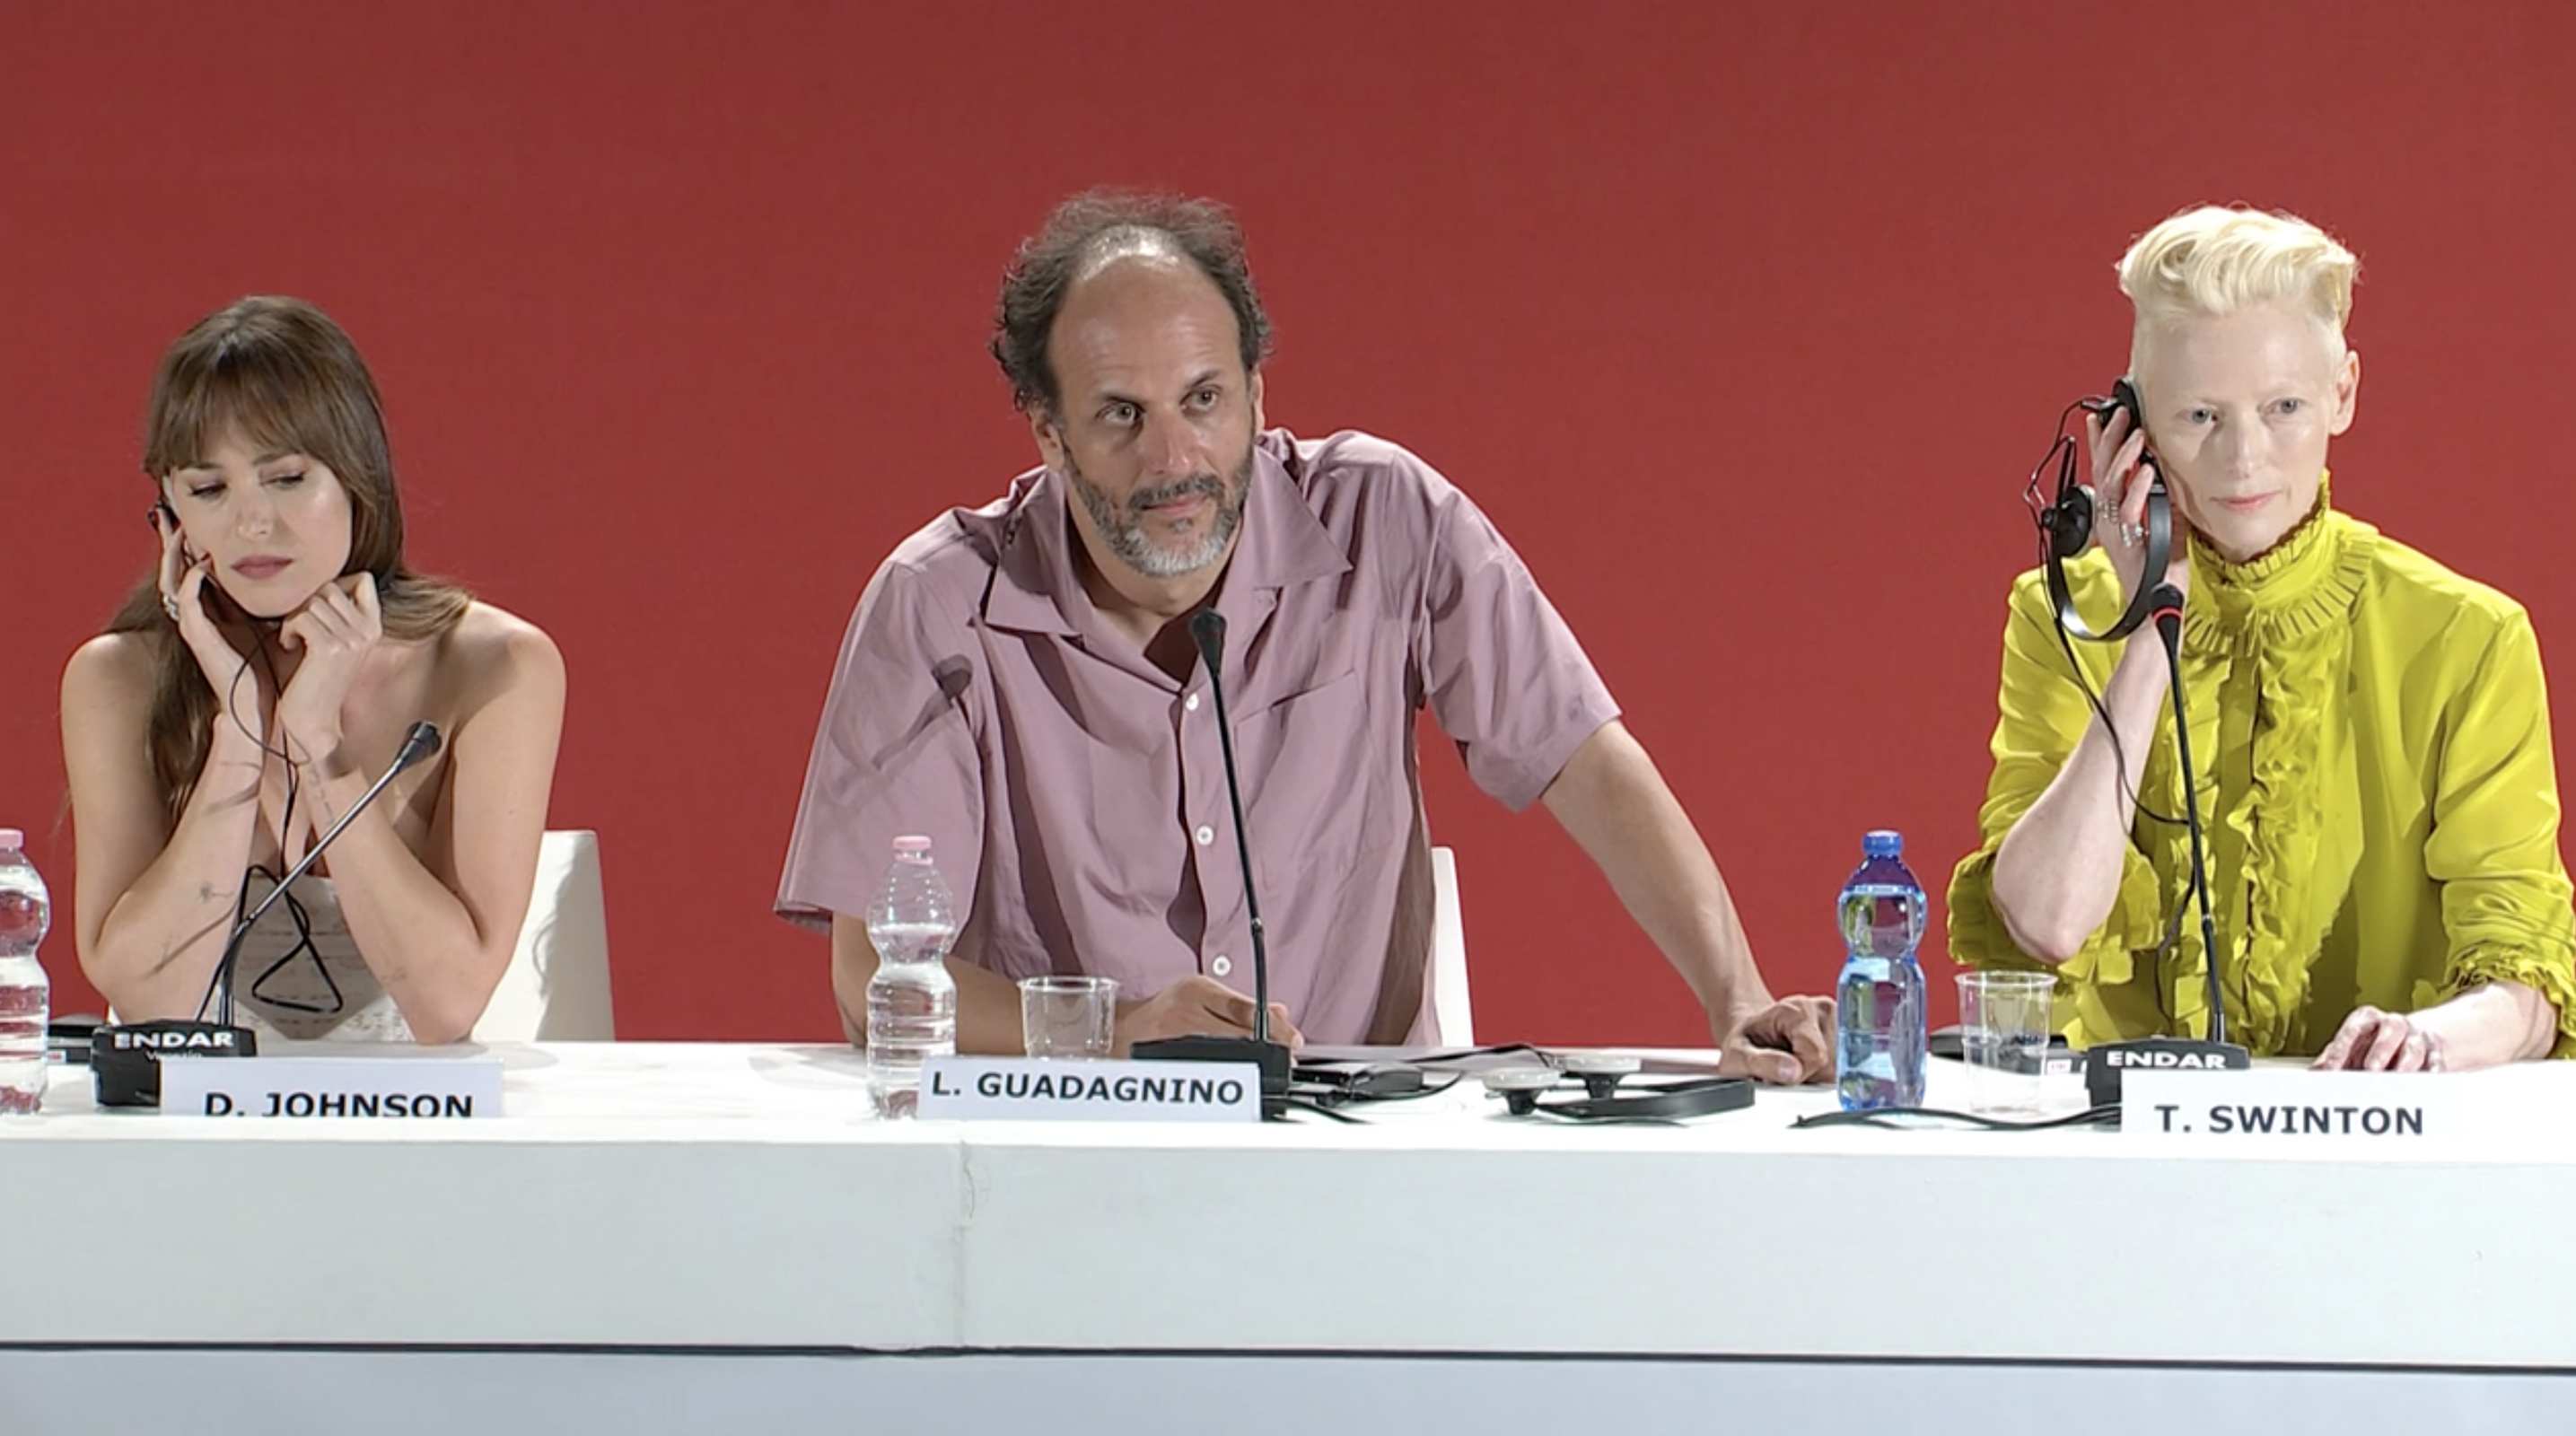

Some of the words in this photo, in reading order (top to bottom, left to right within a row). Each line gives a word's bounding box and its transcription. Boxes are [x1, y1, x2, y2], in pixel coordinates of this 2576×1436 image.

[114, 1031, 234, 1048] ENDAR
[2106, 1049, 2227, 1069] ENDAR
[932, 1071, 961, 1096] L.
[977, 1071, 1244, 1105] GUADAGNINO
[204, 1091, 245, 1116] D.
[262, 1091, 472, 1117] JOHNSON
[2154, 1105, 2191, 1132] T.
[2208, 1105, 2423, 1134] SWINTON
